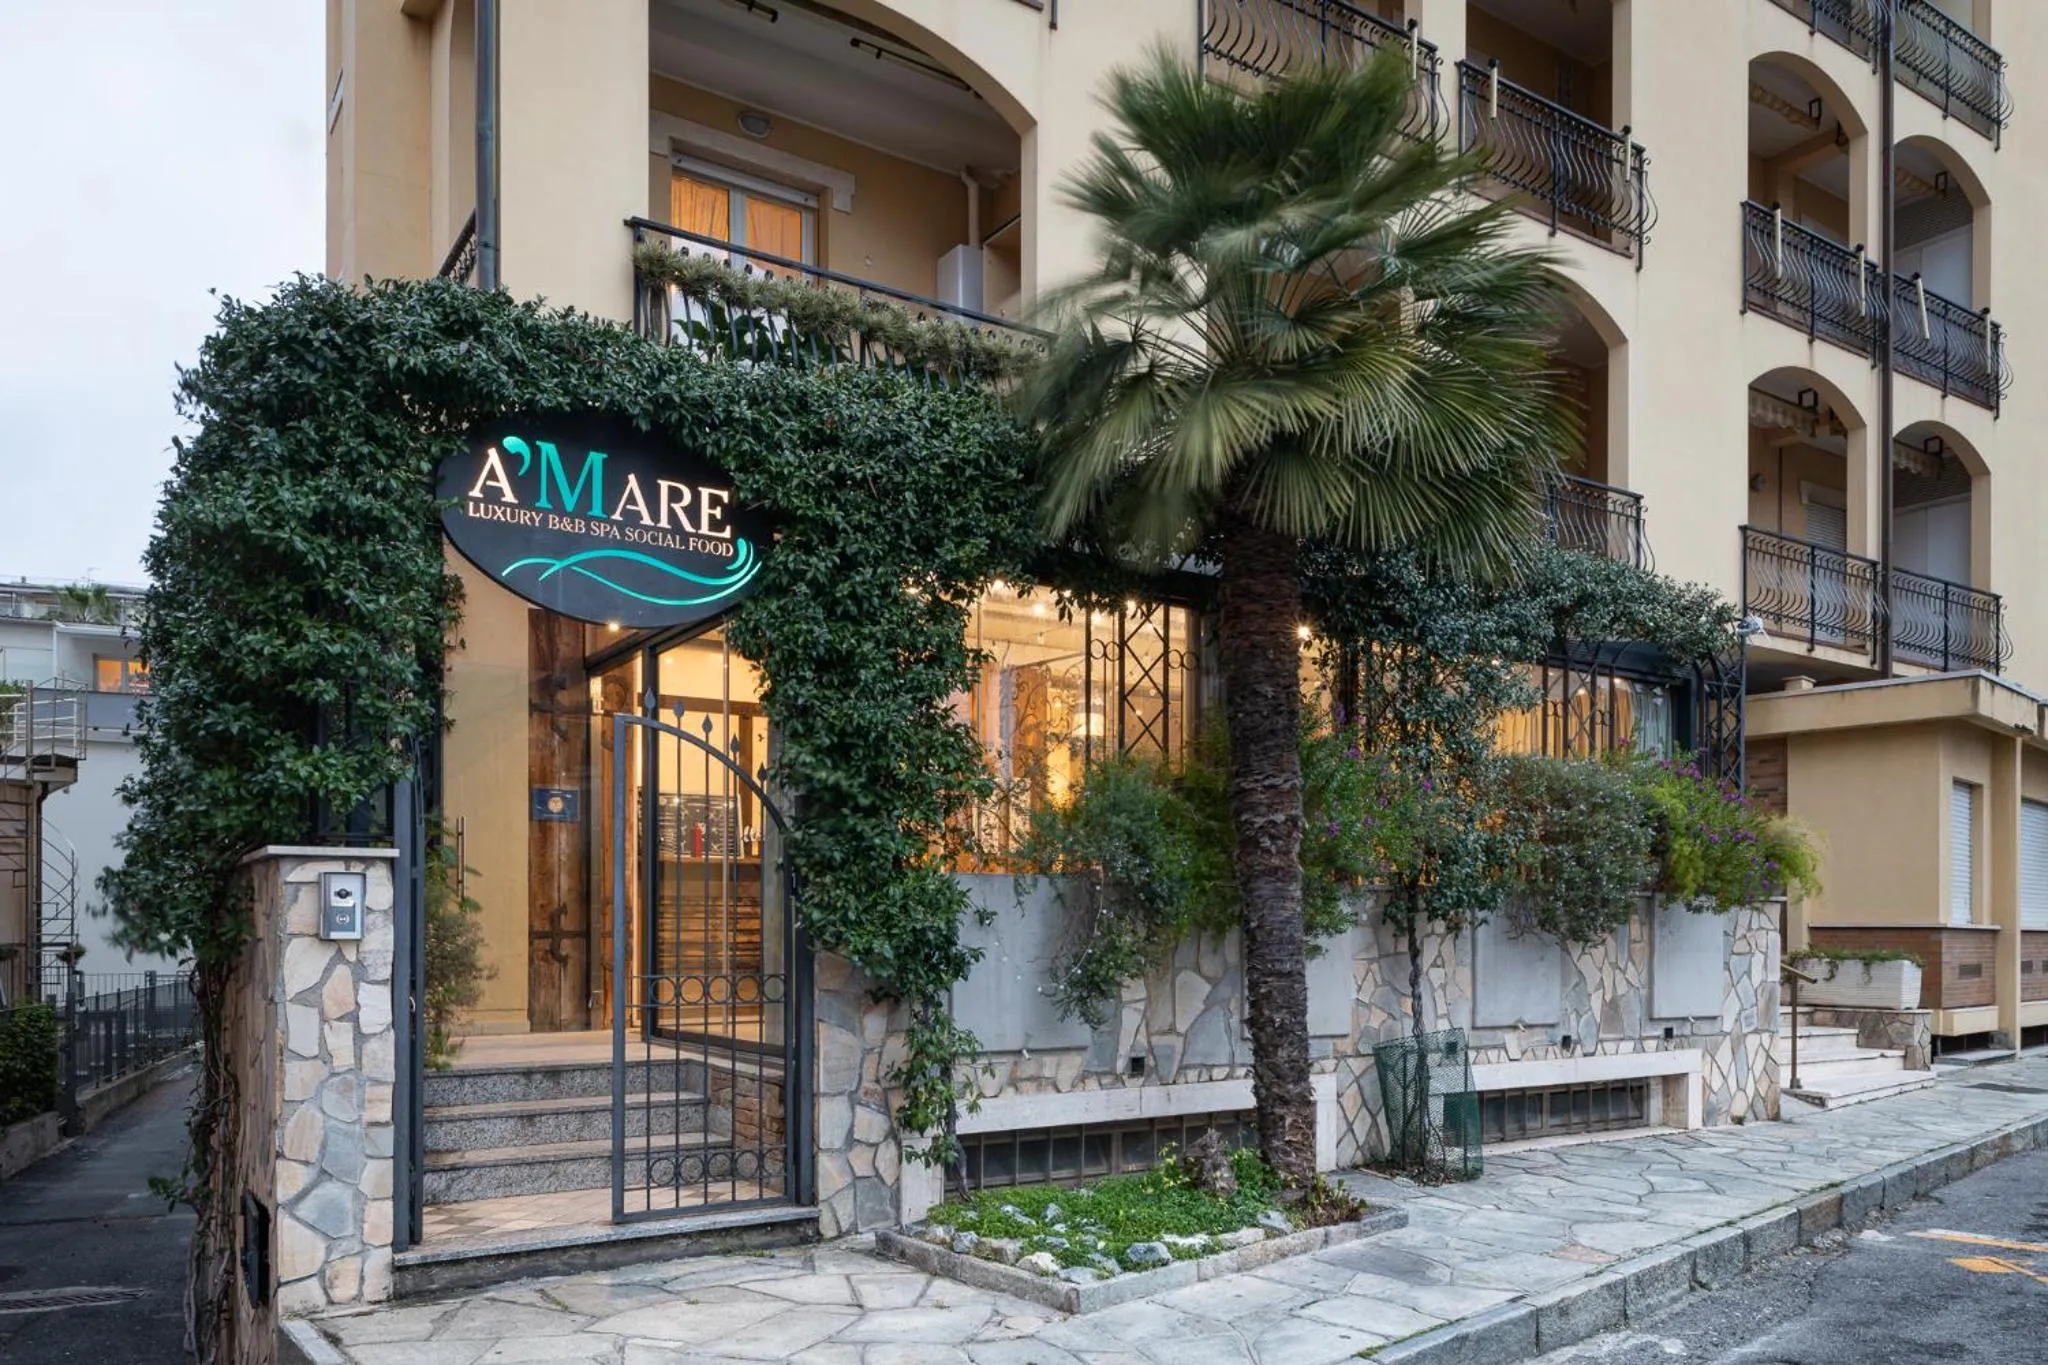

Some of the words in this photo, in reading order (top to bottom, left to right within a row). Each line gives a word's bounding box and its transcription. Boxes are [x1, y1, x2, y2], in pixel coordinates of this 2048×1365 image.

[468, 436, 732, 539] A'MARE
[468, 502, 543, 527] LUXURY
[548, 514, 586, 534] B&B
[590, 521, 622, 540] SPA
[624, 528, 685, 550] SOCIAL
[689, 538, 734, 557] FOOD
